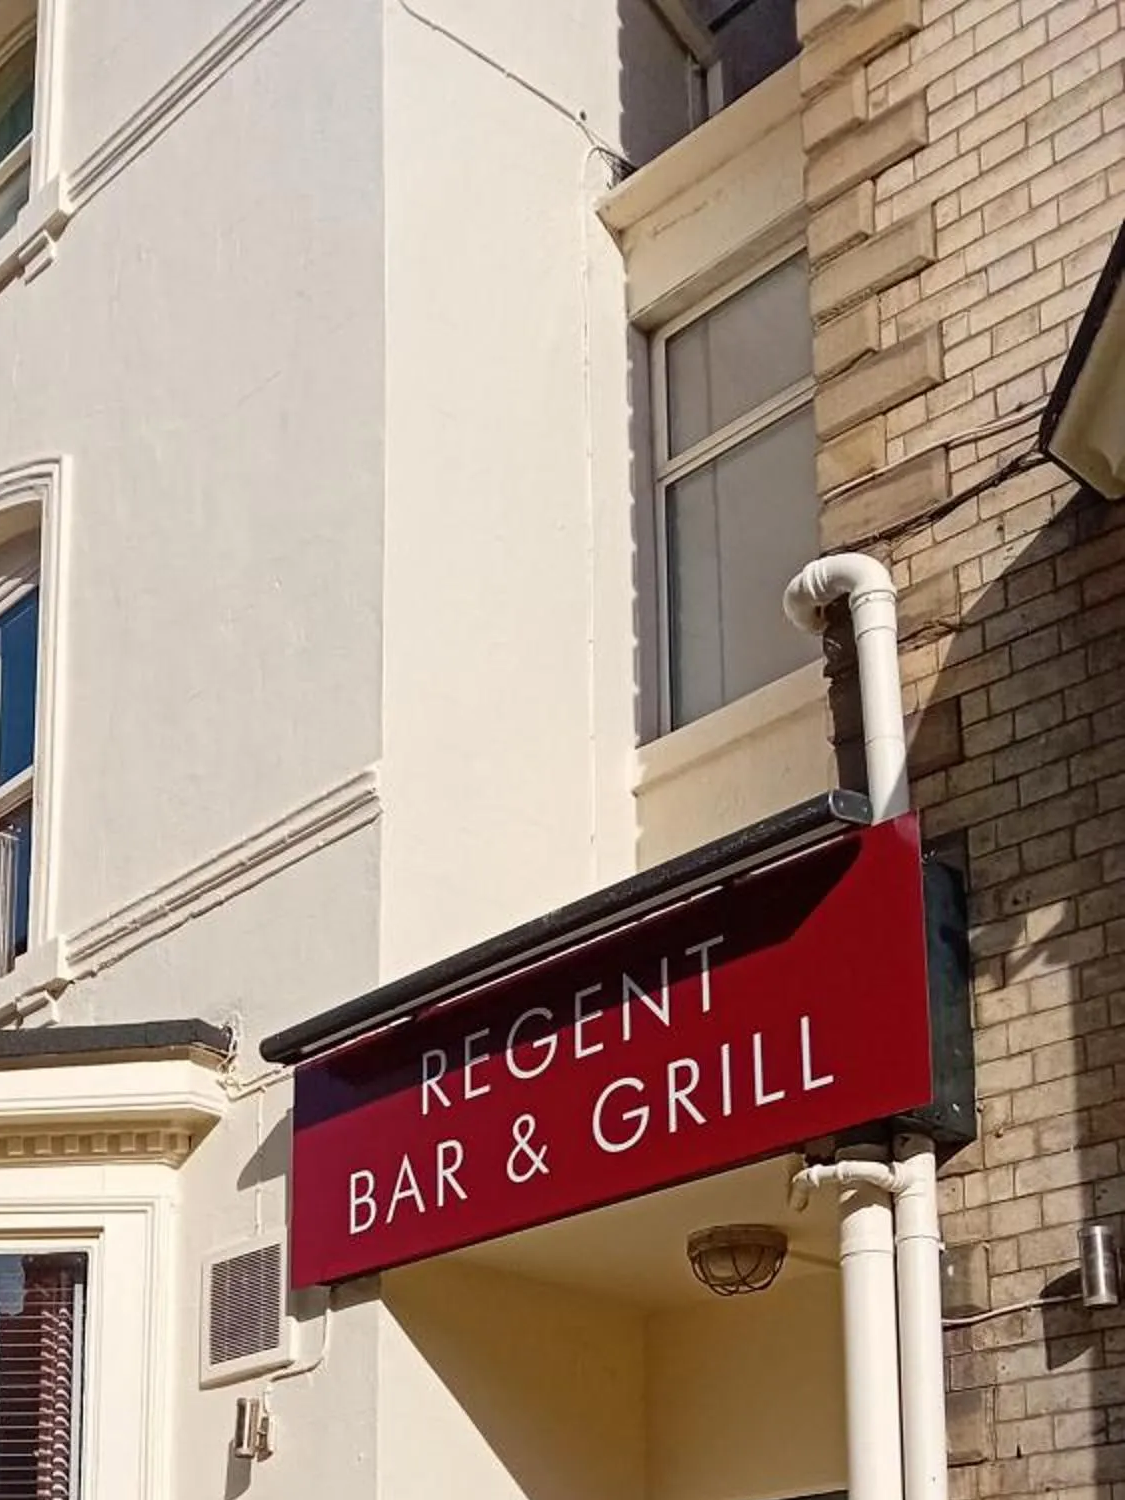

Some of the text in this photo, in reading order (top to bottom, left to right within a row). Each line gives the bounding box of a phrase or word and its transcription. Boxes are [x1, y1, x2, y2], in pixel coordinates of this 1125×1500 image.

[348, 1015, 835, 1235] BAR & GRILL
[421, 935, 725, 1115] REGENT
